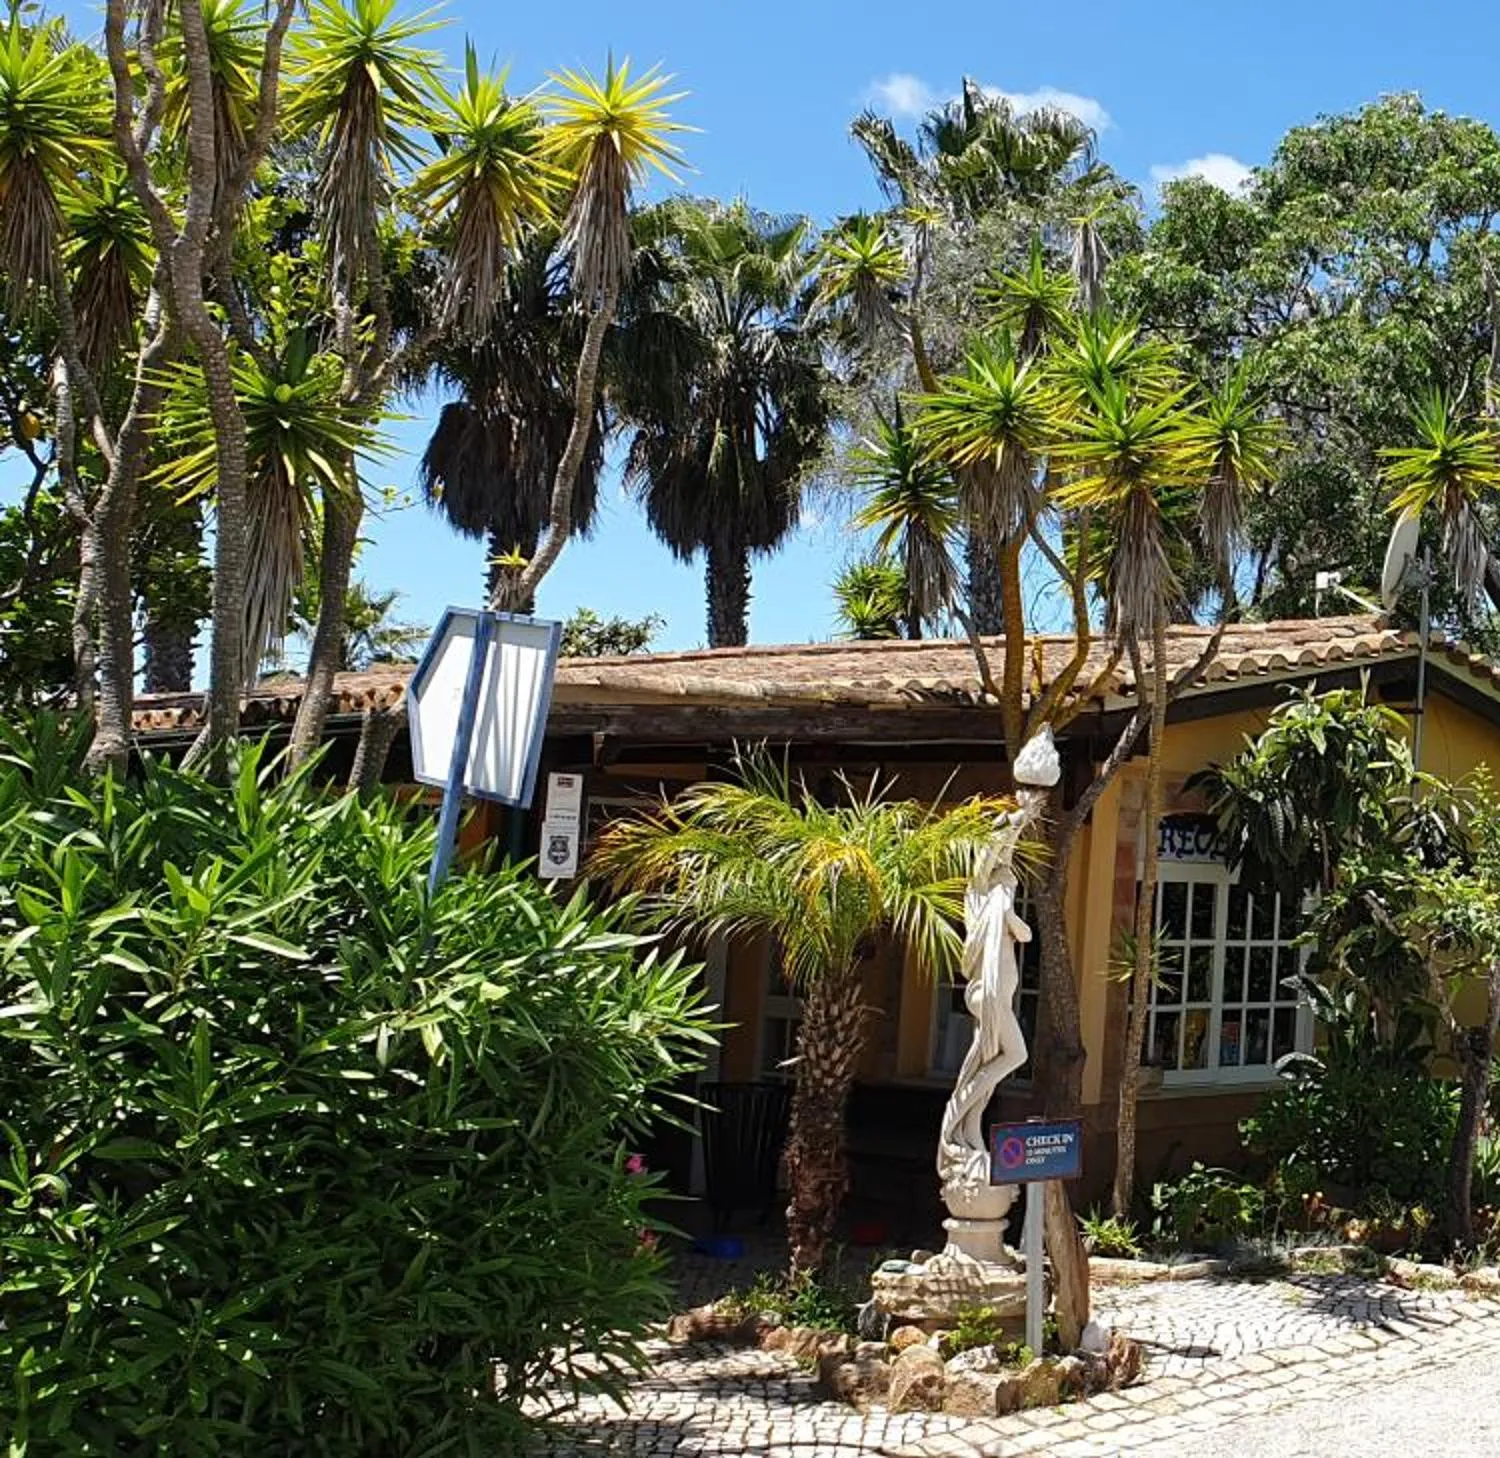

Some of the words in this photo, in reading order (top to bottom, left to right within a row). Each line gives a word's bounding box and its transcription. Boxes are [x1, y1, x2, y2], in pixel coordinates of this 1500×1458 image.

[1025, 1134, 1061, 1147] CHECK
[1061, 1132, 1075, 1144] IN
[1025, 1156, 1046, 1166] ONLY
